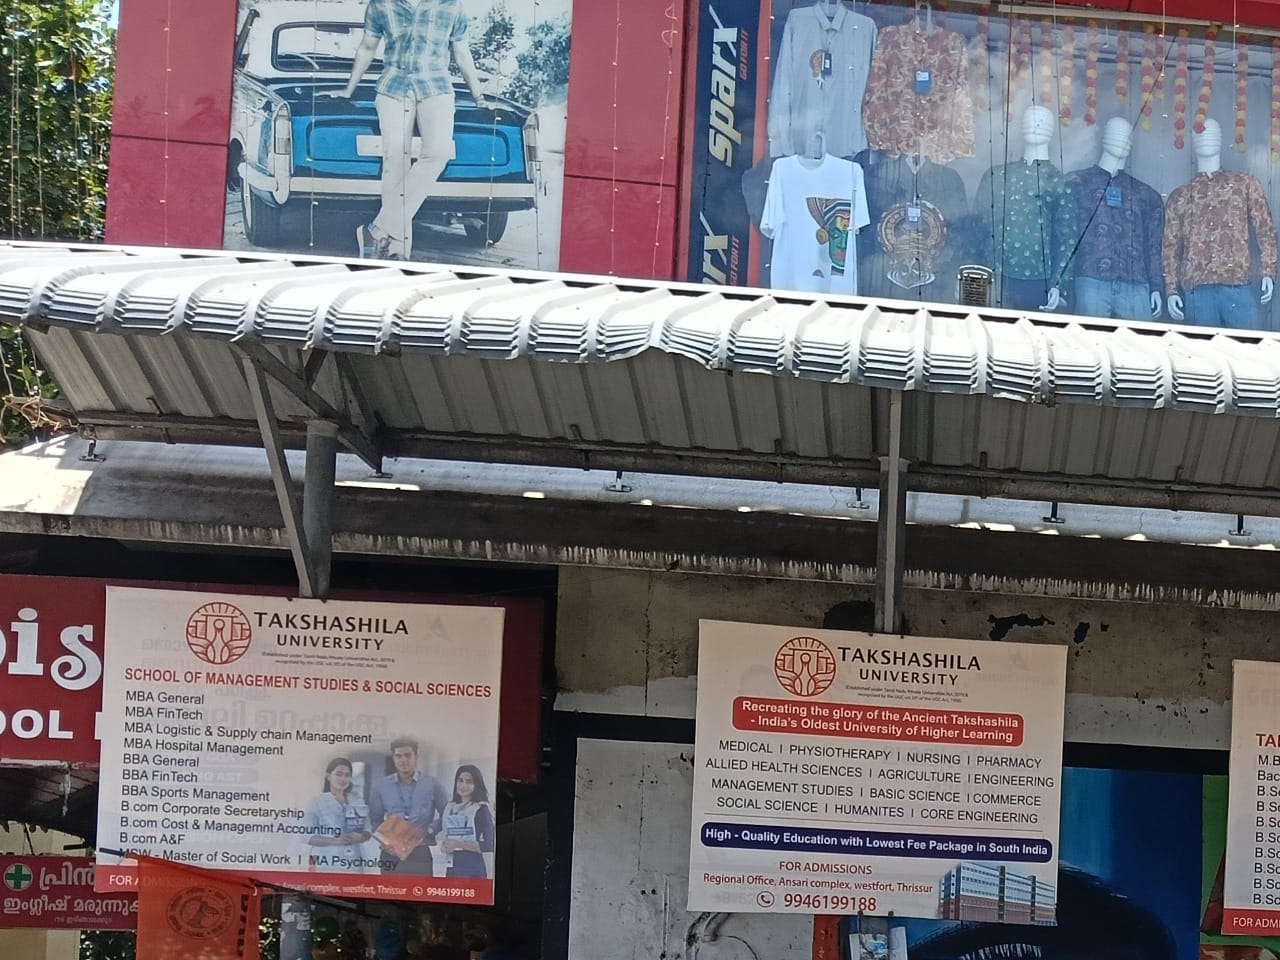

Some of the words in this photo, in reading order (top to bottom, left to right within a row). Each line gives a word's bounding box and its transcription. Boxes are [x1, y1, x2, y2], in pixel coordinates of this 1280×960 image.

[739, 68, 747, 80] GO
[708, 3, 742, 168] sparx
[255, 611, 408, 636] TAKSHASHILA
[0, 607, 102, 691] is
[277, 634, 384, 652] UNIVERSITY
[838, 646, 981, 671] TAKSHASHILA
[125, 668, 181, 683] SCHOOL
[186, 670, 203, 684] OF
[205, 671, 300, 690] MANAGEMENT
[303, 676, 360, 692] STUDIES
[363, 679, 372, 692] &
[375, 680, 424, 695] SOCIAL
[427, 682, 492, 698] SCIENCES
[859, 668, 959, 686] UNIVERSITY
[126, 690, 154, 703] MBA
[157, 691, 205, 705] General
[742, 700, 806, 717] Recreating
[810, 704, 828, 717] the
[833, 706, 860, 721] glory
[864, 708, 878, 720] of
[881, 709, 899, 722] the
[902, 710, 947, 725] Ancient
[951, 713, 1018, 729] Takshashila
[719, 739, 773, 754] MEDICAL
[789, 744, 891, 761] PHYSIOTHERAPY
[907, 752, 961, 765] NURSING
[977, 755, 1042, 769] PHARMACY
[122, 785, 148, 798] BBA
[151, 786, 189, 803] Sports
[192, 787, 270, 804] Management
[779, 860, 801, 872] FOR
[804, 862, 872, 875] ADMISSIONS
[426, 887, 476, 899] 9946199188
[784, 893, 877, 912] 9946199188
